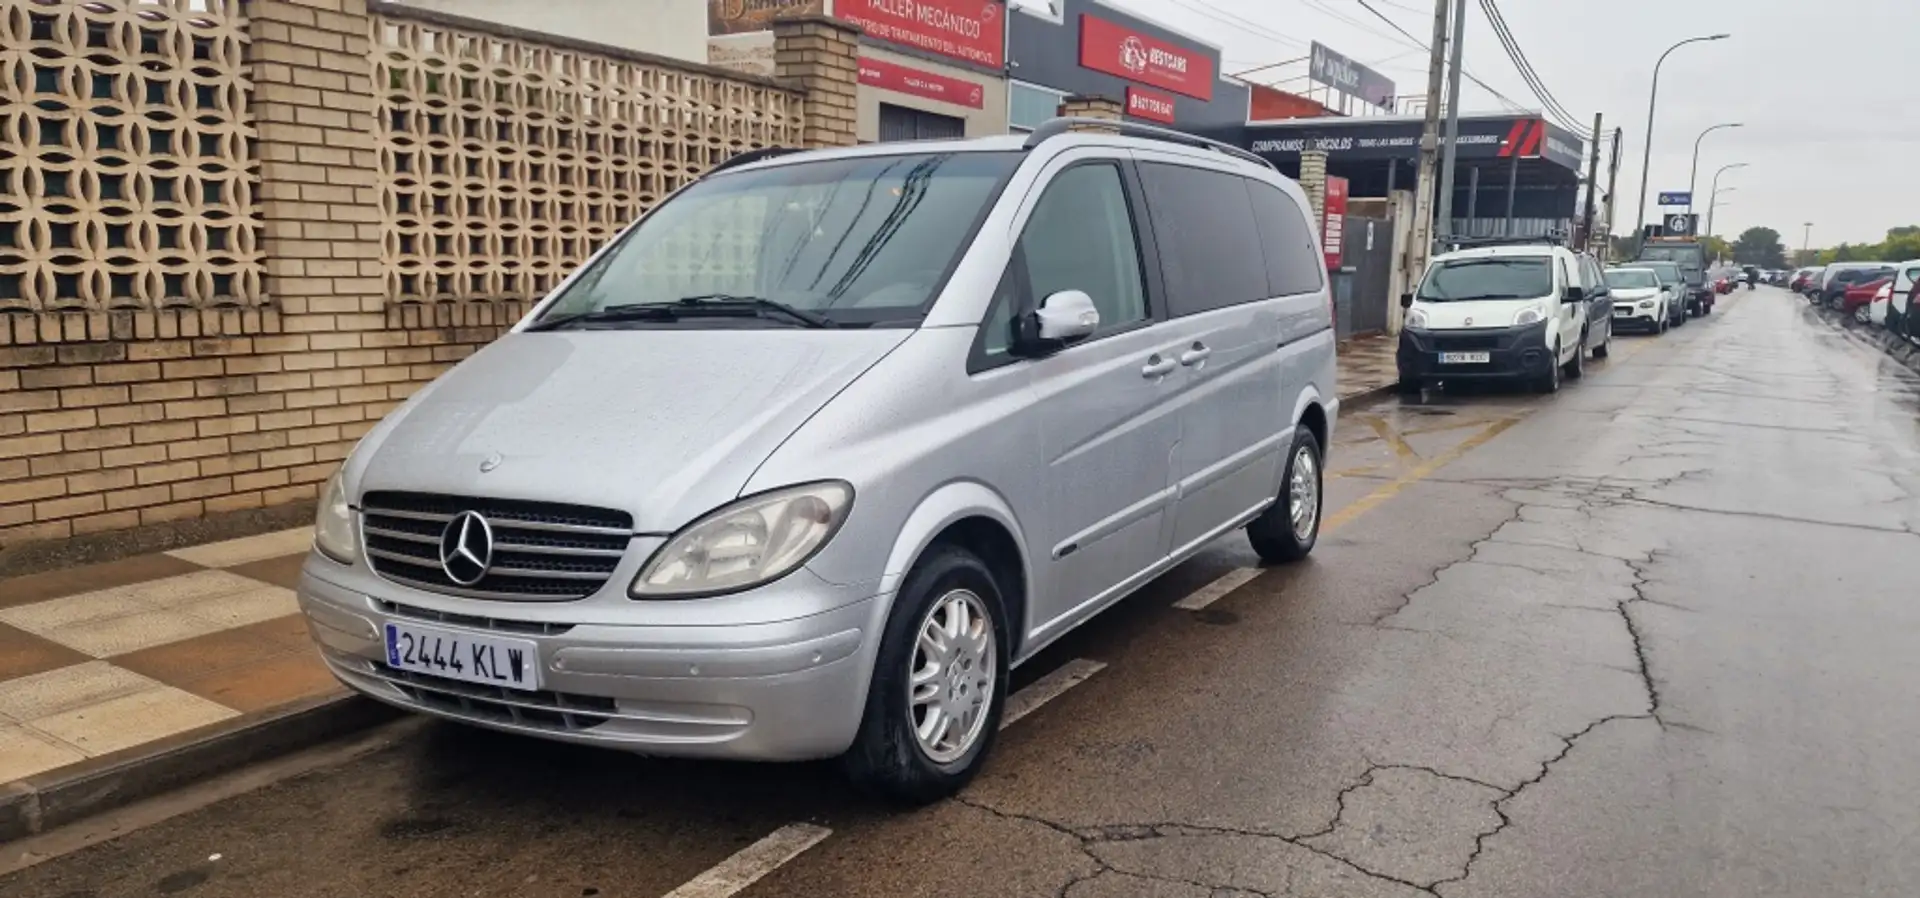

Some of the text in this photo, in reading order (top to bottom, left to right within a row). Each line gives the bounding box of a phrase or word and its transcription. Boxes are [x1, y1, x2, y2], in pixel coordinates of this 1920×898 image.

[916, 3, 980, 40] MECÁNICO
[878, 25, 889, 37] DE
[890, 26, 942, 52] TRATAMIENTO
[943, 41, 956, 55] DEL
[1149, 47, 1187, 73] BESTCARS
[1251, 139, 1304, 153] COMPRAMOS
[401, 631, 524, 683] 2444 KLW
